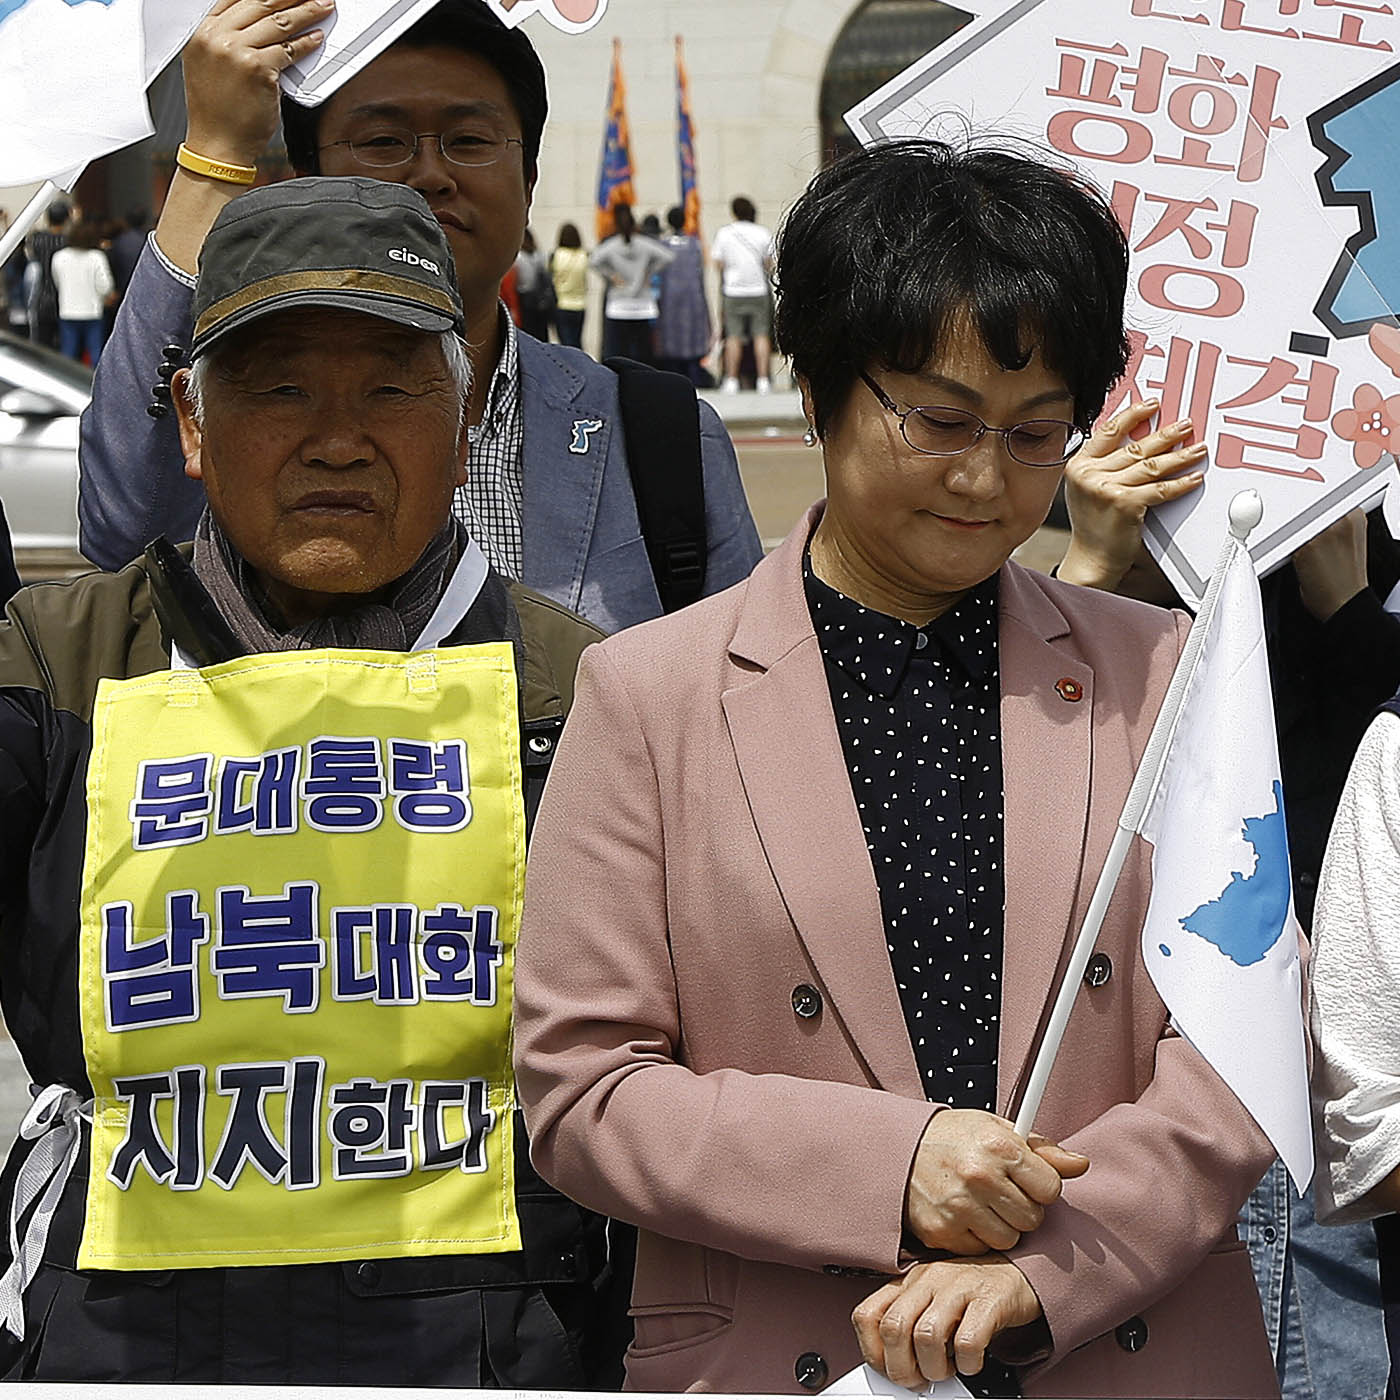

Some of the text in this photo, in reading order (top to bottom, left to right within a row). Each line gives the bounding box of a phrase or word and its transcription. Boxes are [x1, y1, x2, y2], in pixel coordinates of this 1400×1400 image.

[1046, 37, 1289, 183] 평화
[1109, 180, 1260, 318] 정
[133, 737, 470, 848] 문대통령
[109, 1059, 493, 1189] 지지한다
